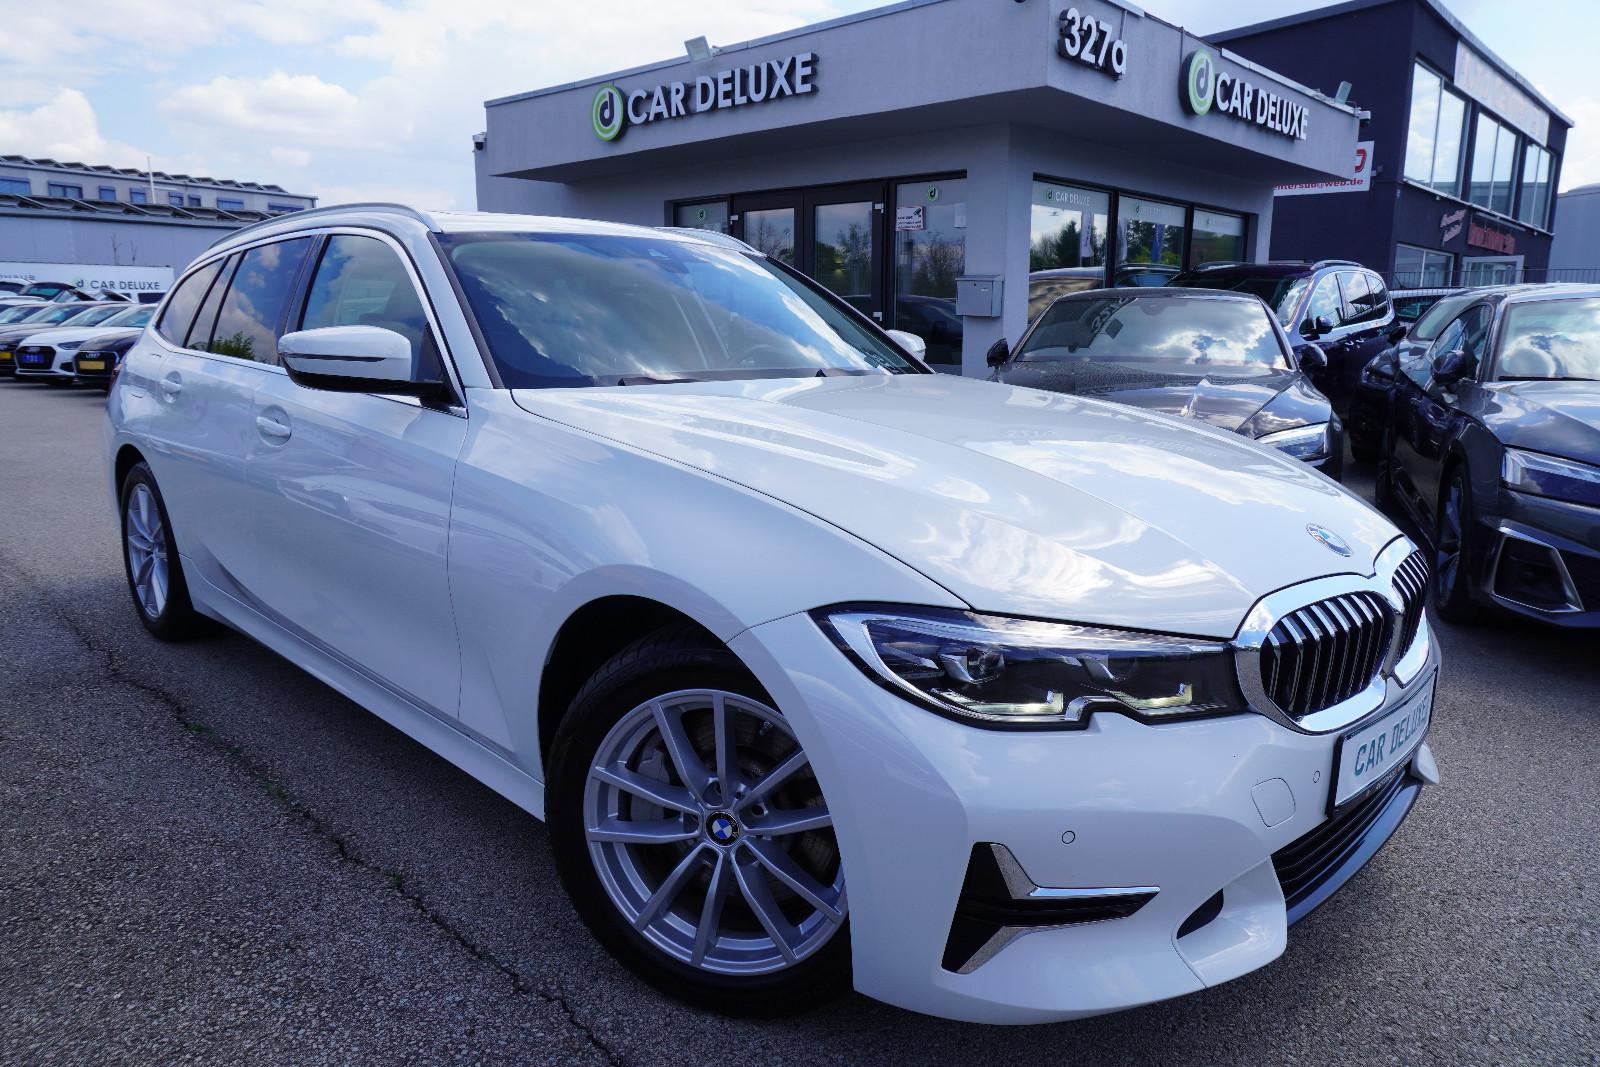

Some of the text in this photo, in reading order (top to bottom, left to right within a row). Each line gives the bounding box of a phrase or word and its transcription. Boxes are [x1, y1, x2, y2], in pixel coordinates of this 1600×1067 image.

[1060, 8, 1127, 75] 327a
[627, 81, 686, 125] CAR
[696, 52, 814, 112] DELUXE
[1216, 71, 1252, 120] CAR
[1256, 88, 1308, 140] DELUXE
[90, 280, 116, 289] CAR
[119, 281, 160, 290] DELUXE
[1354, 732, 1386, 777] CAR
[1390, 694, 1428, 754] DELUXE
